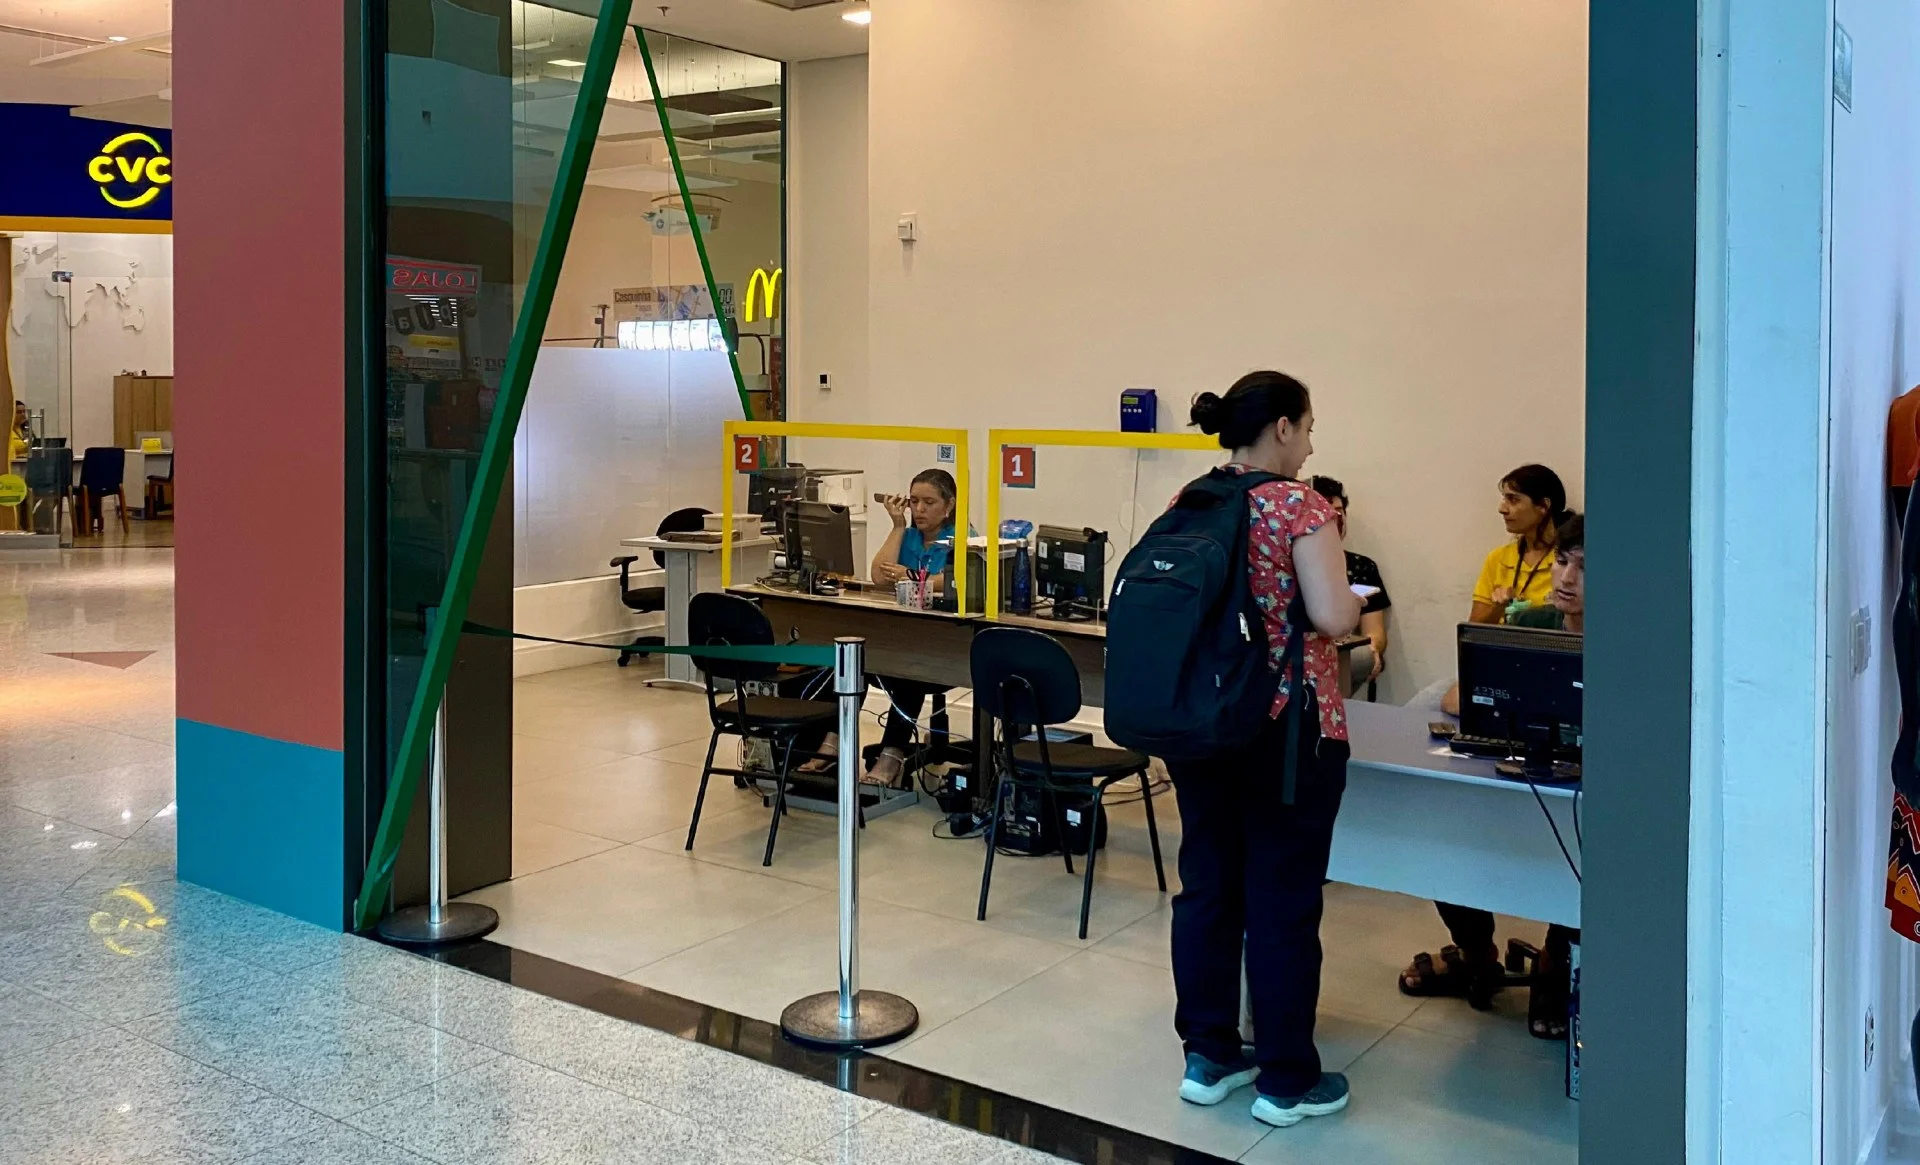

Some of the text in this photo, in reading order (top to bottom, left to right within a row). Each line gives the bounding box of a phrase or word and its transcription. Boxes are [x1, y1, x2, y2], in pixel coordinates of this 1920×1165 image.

[88, 156, 172, 183] CVC
[741, 443, 752, 463] 2
[1011, 454, 1024, 476] 1
